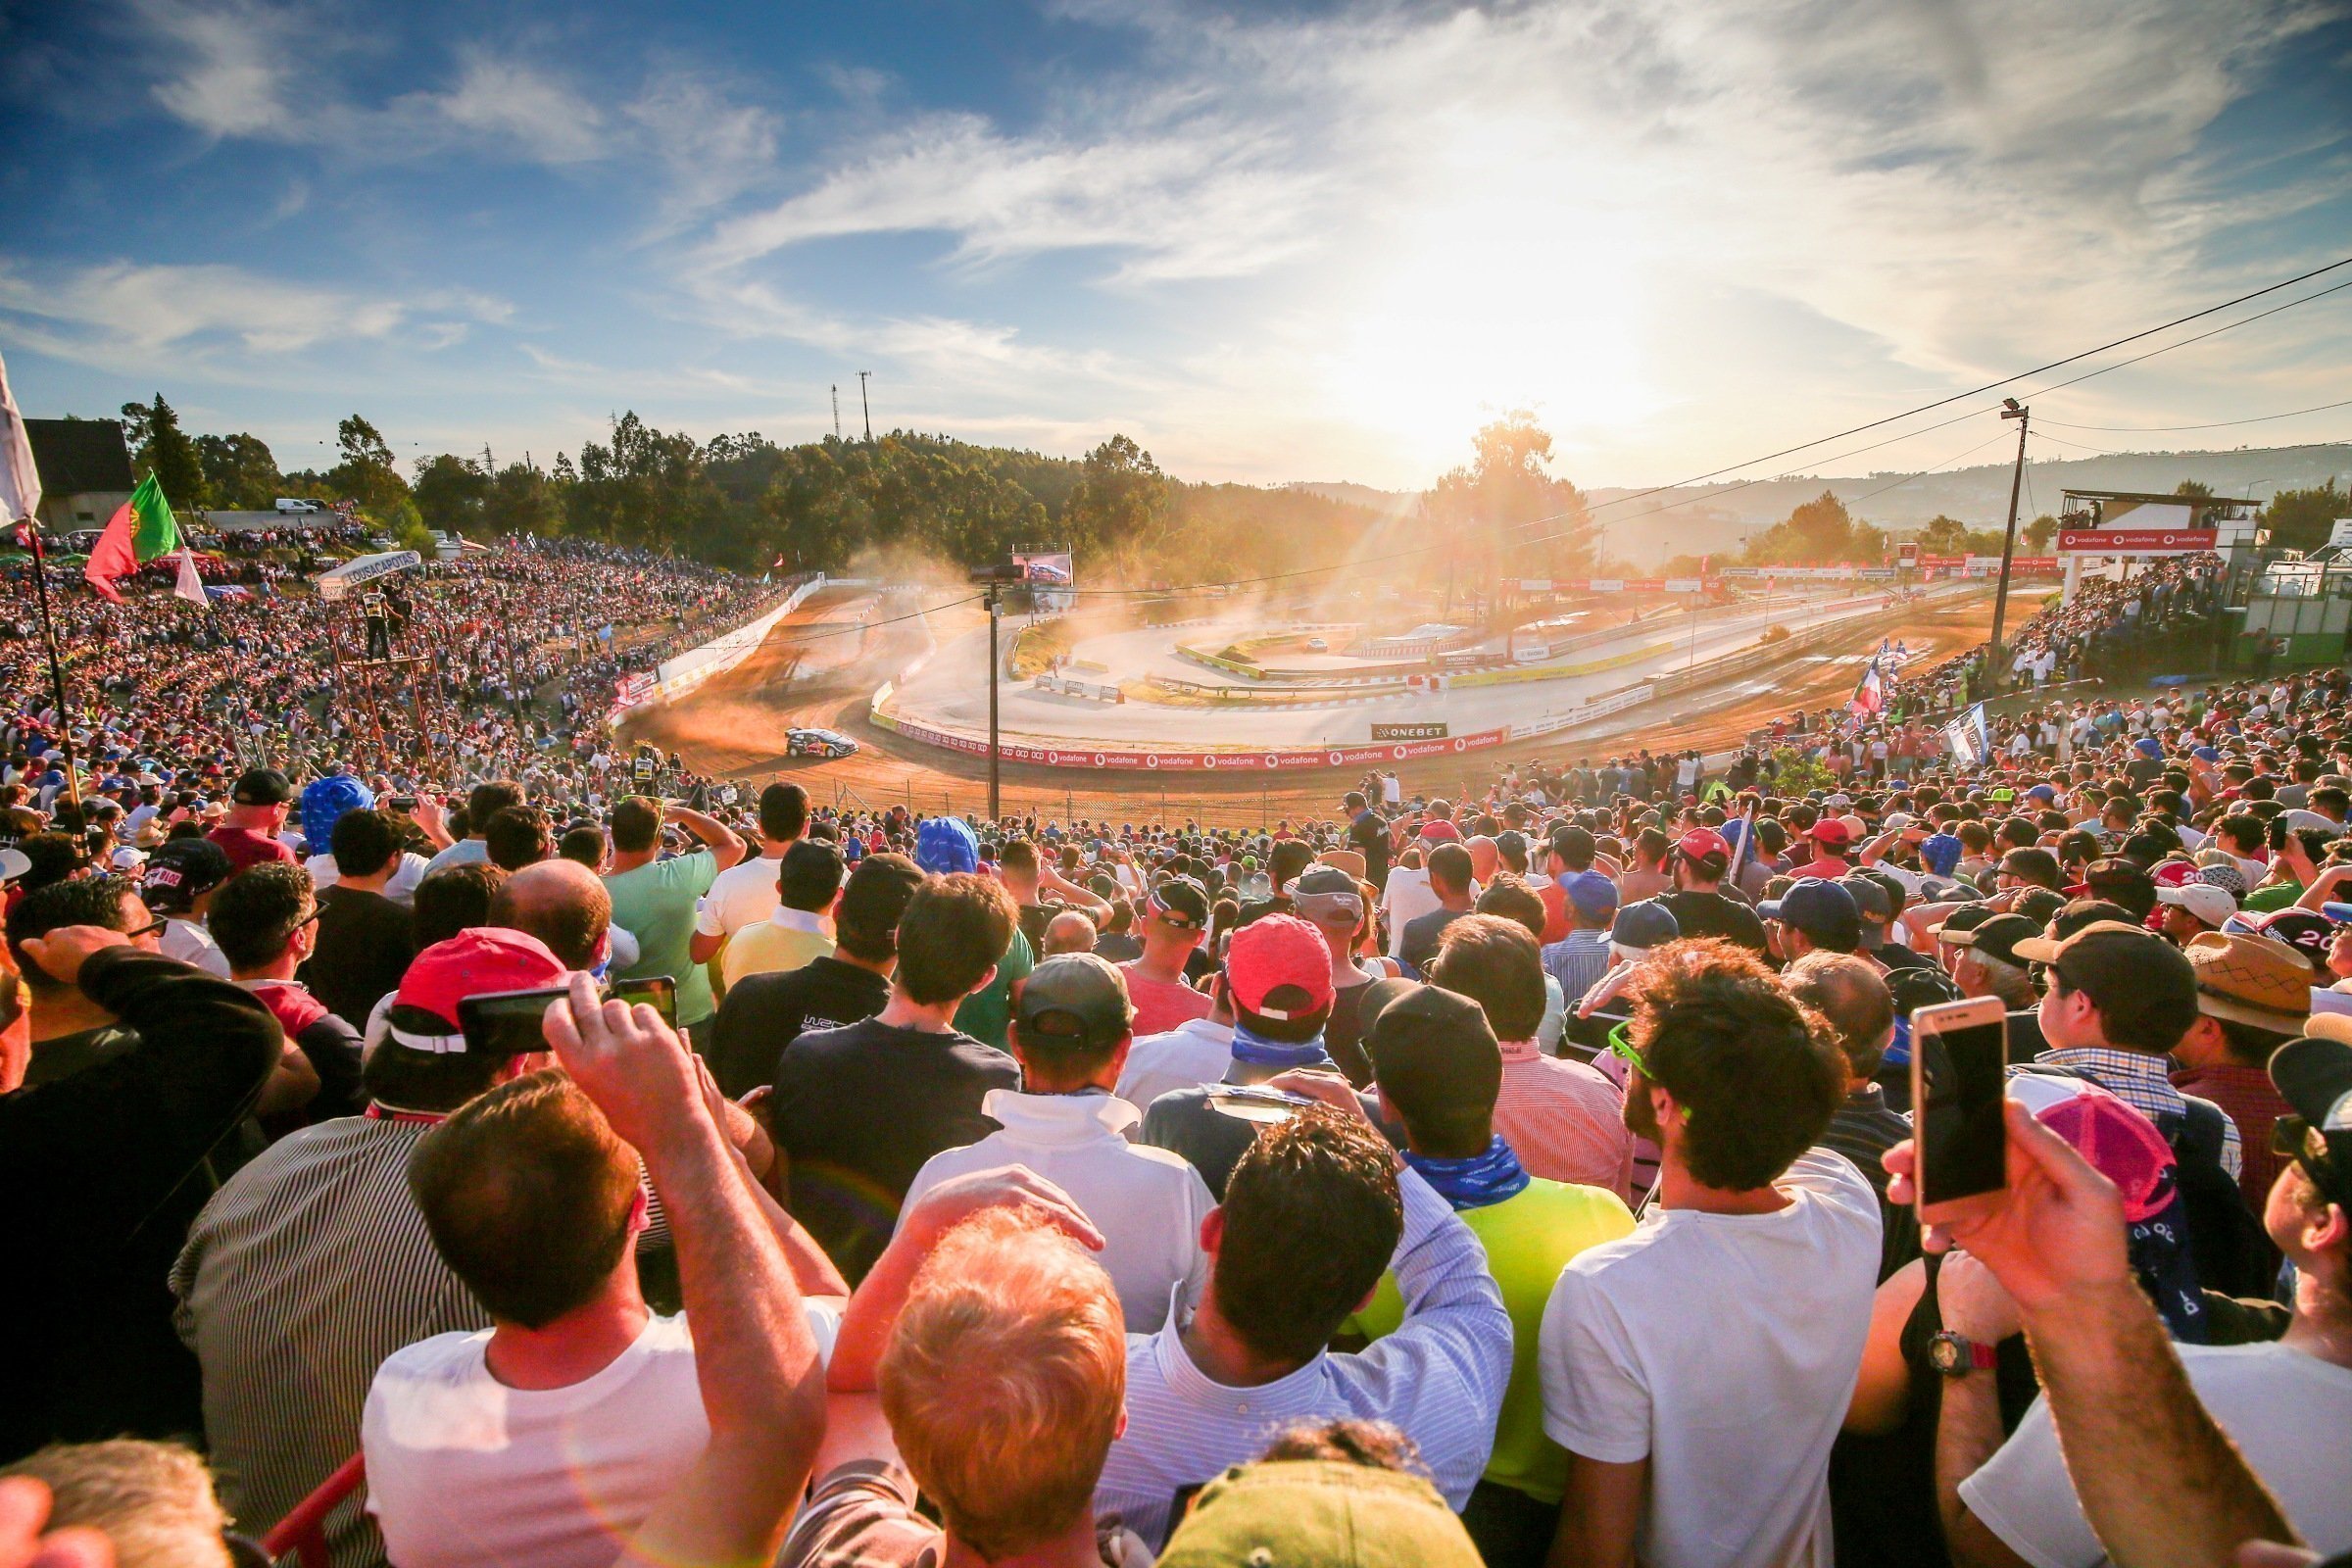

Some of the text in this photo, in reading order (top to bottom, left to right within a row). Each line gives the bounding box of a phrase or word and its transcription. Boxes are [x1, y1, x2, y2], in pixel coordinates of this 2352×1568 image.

[347, 552, 416, 584] LOUSACAPOTAS
[1390, 726, 1444, 737] ONEBET
[1466, 735, 1498, 747] vodafone
[1408, 743, 1446, 756] vodafone
[1058, 754, 1088, 762] vodafone
[1106, 756, 1138, 764] vodafone
[1280, 755, 1319, 764] vodafone
[1344, 751, 1383, 762] vodafone
[159, 870, 181, 885] 2018
[2268, 925, 2290, 944] WRC
